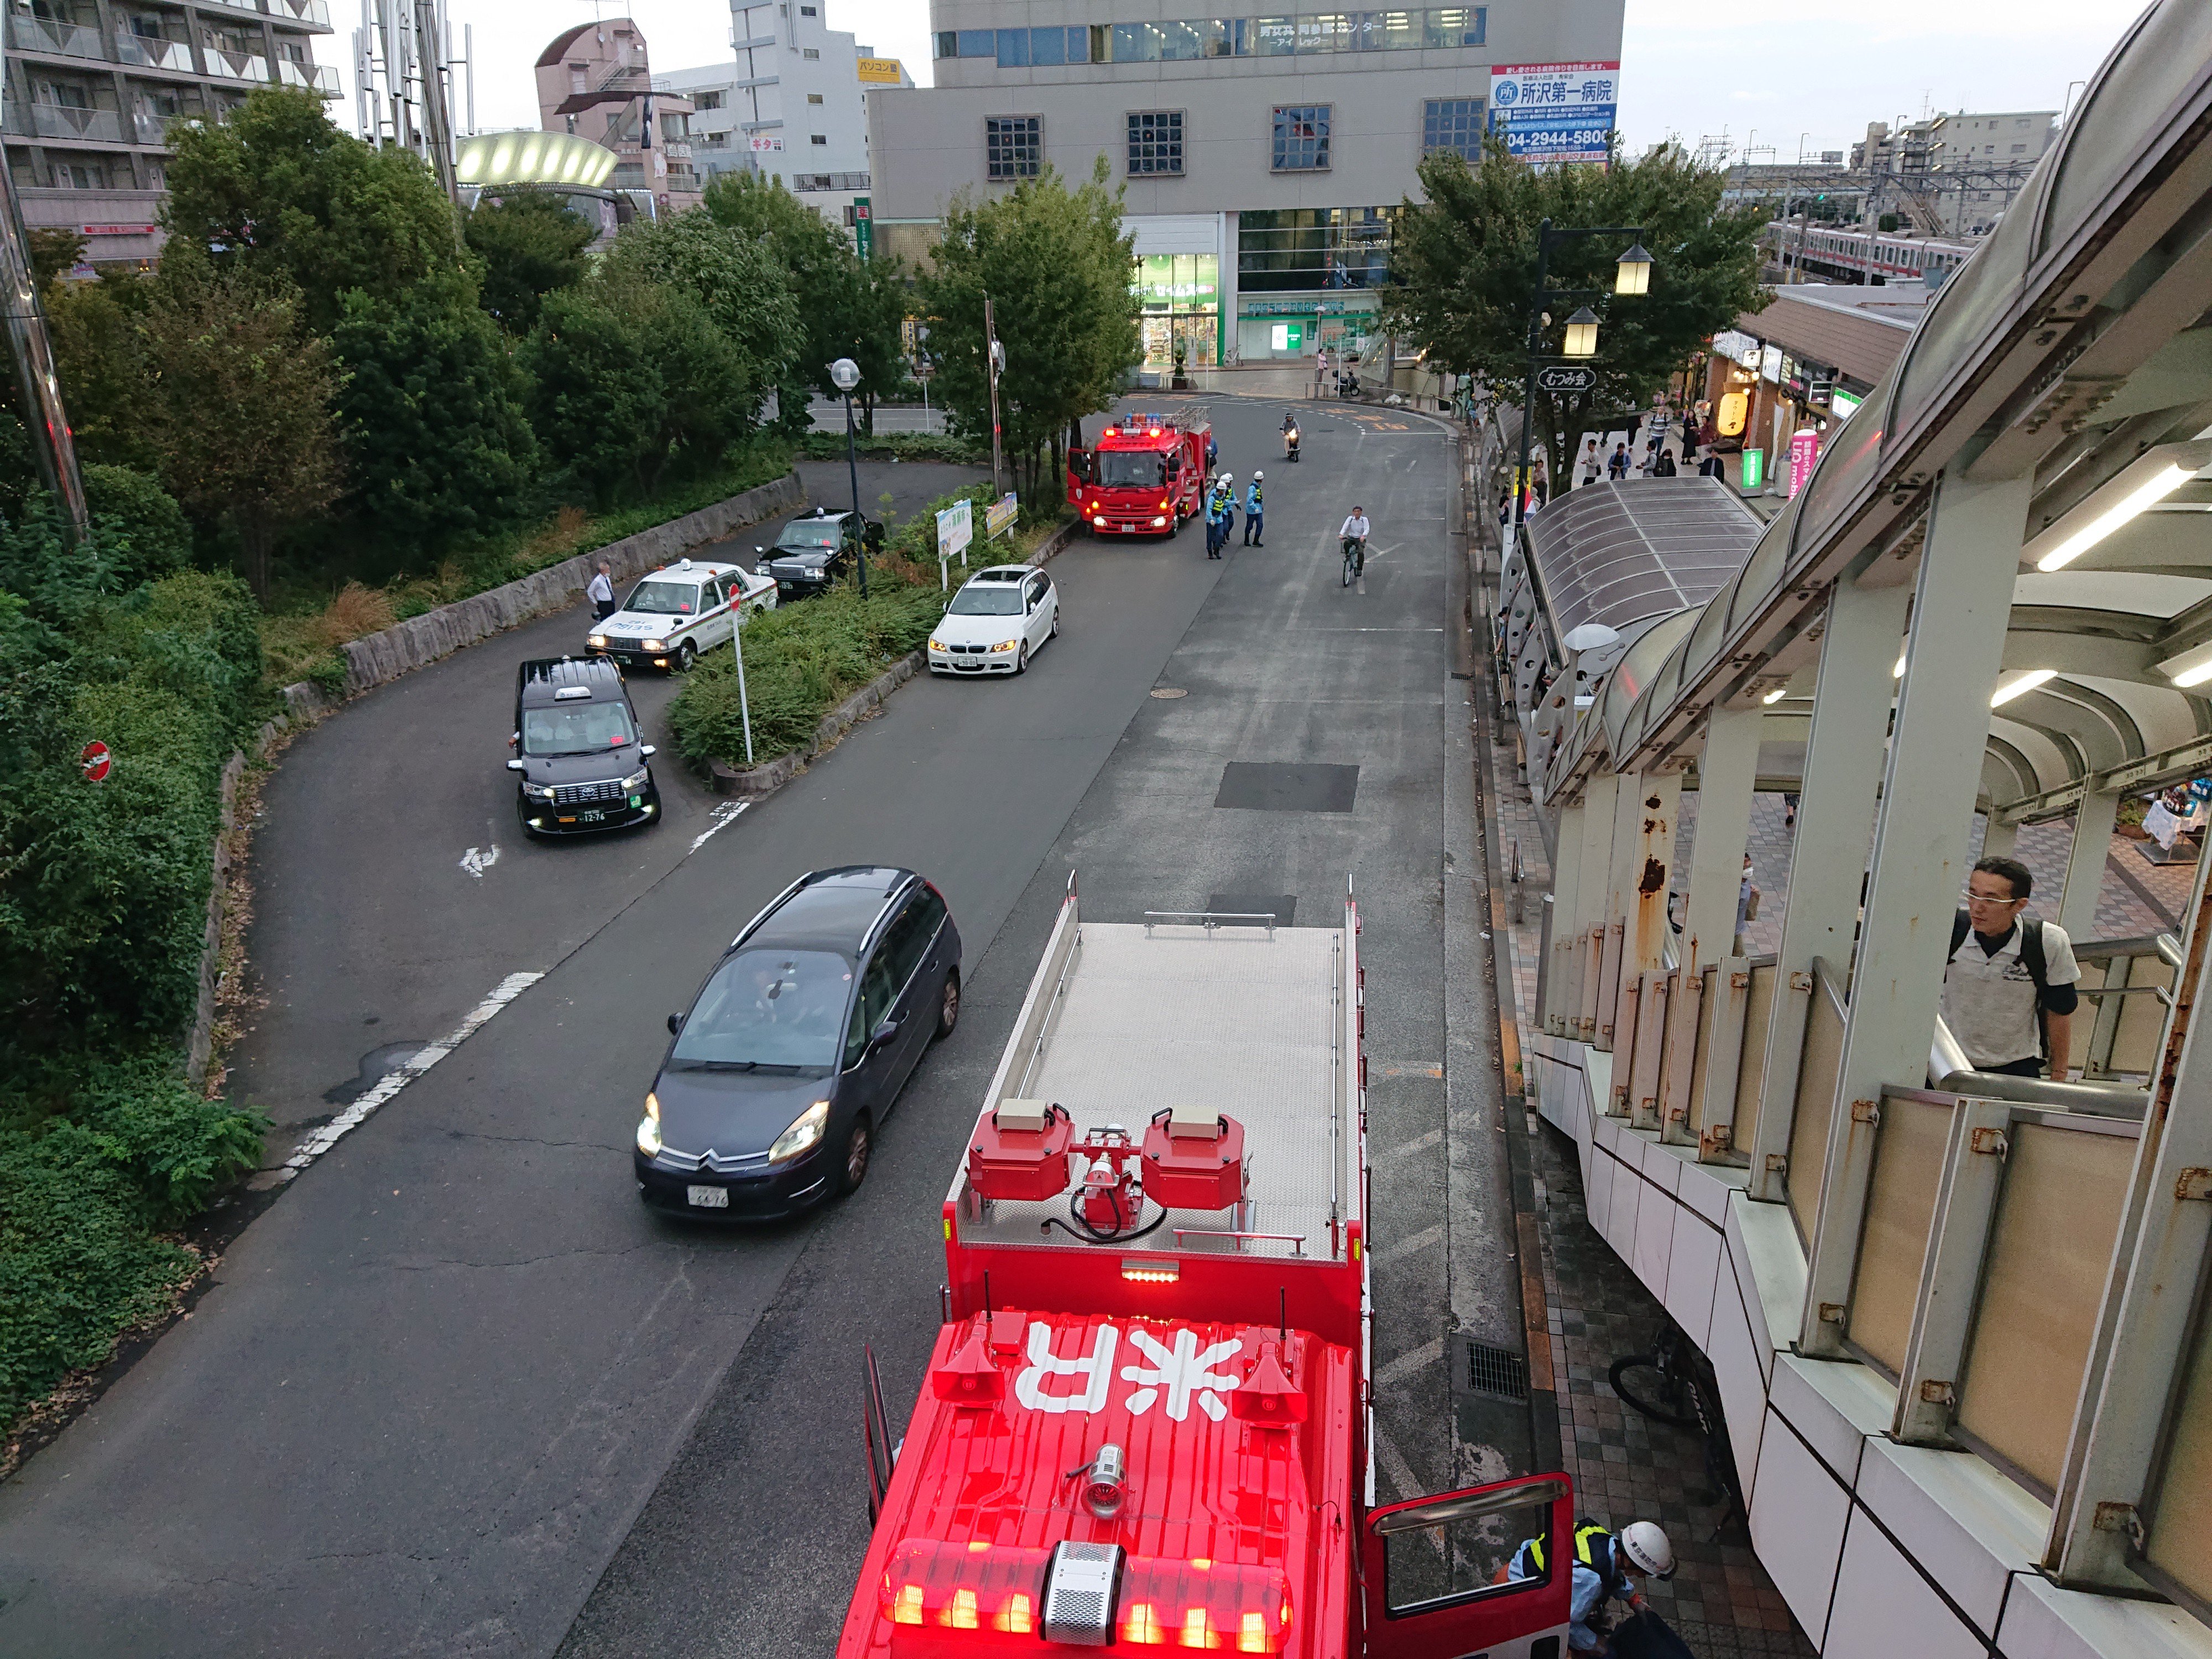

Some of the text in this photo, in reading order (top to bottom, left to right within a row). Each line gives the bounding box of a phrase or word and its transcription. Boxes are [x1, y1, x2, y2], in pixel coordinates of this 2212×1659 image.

[1521, 79, 1612, 104] 所沢第一病院
[857, 206, 868, 218] 薬
[1546, 371, 1587, 386] むつみ会
[1791, 441, 1803, 464] UQ
[611, 623, 654, 631] SEIBU
[584, 813, 606, 822] 12-76
